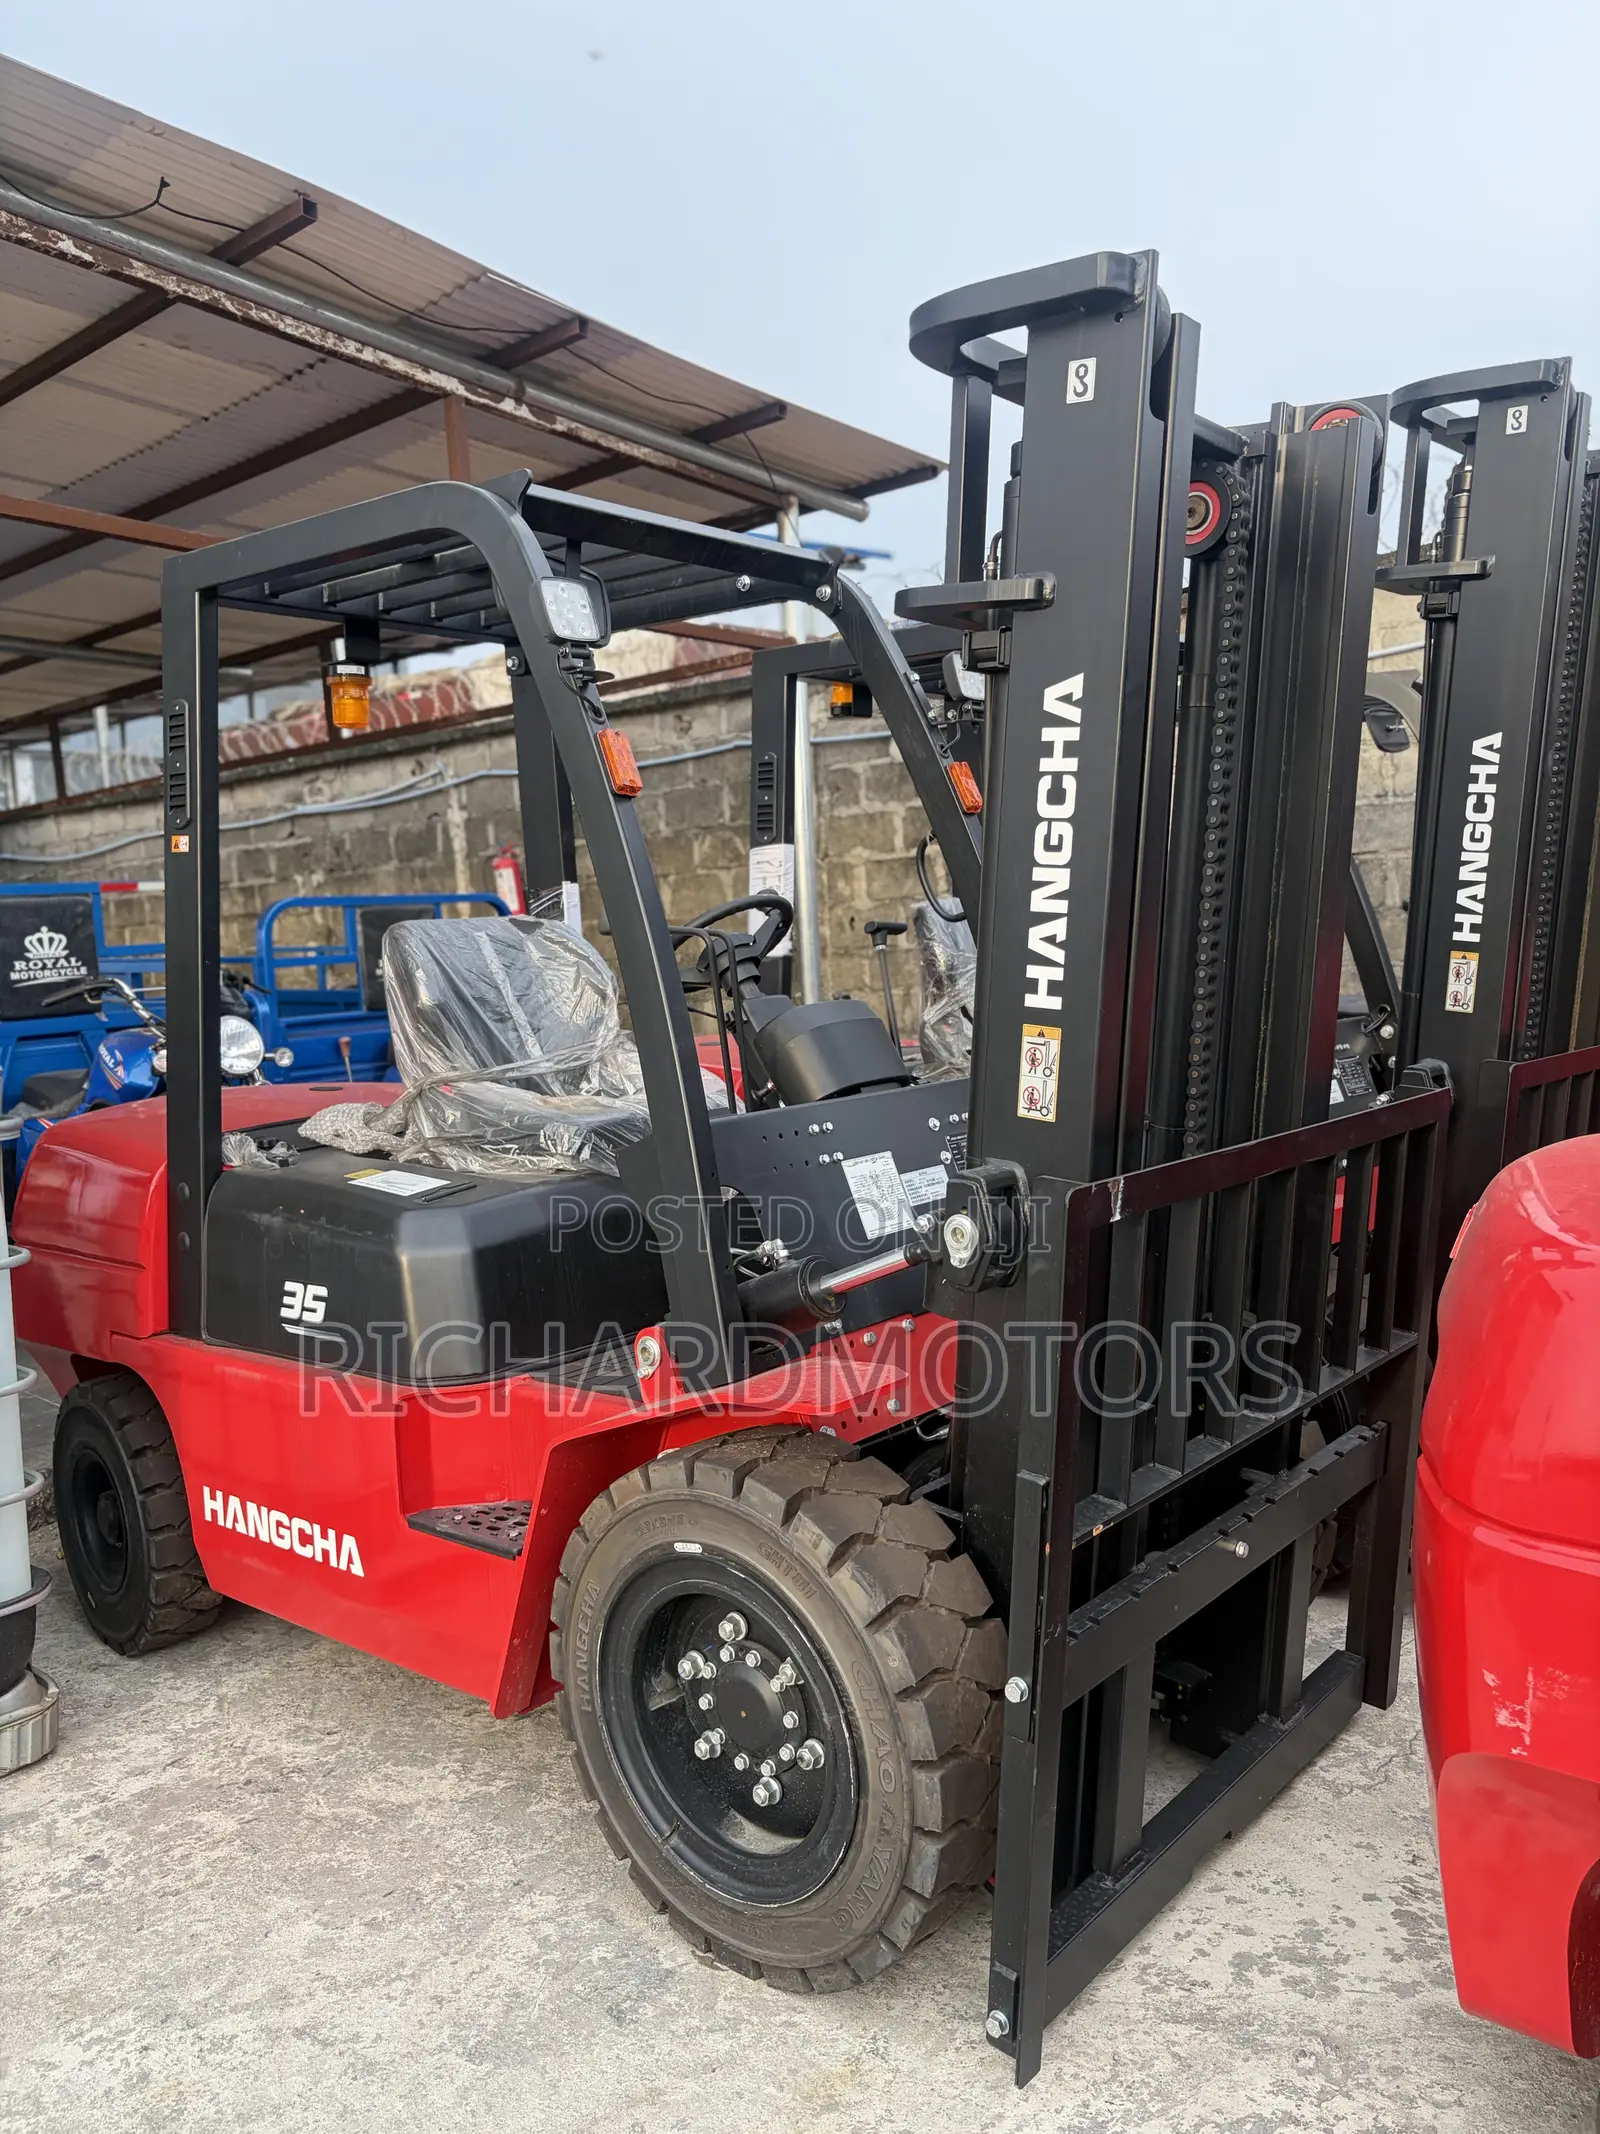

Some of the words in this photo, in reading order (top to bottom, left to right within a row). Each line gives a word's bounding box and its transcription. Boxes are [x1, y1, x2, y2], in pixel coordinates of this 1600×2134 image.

[1024, 672, 1085, 1011] HANGCHA
[1452, 731, 1503, 943] HANGCHA
[10, 967, 88, 980] MOTORCYCLE
[12, 957, 82, 971] ROYAL
[279, 1280, 329, 1324] 35
[202, 1485, 365, 1577] HANGCHA
[575, 1579, 601, 1713] HANGCHA
[851, 1660, 897, 1794] CHAO
